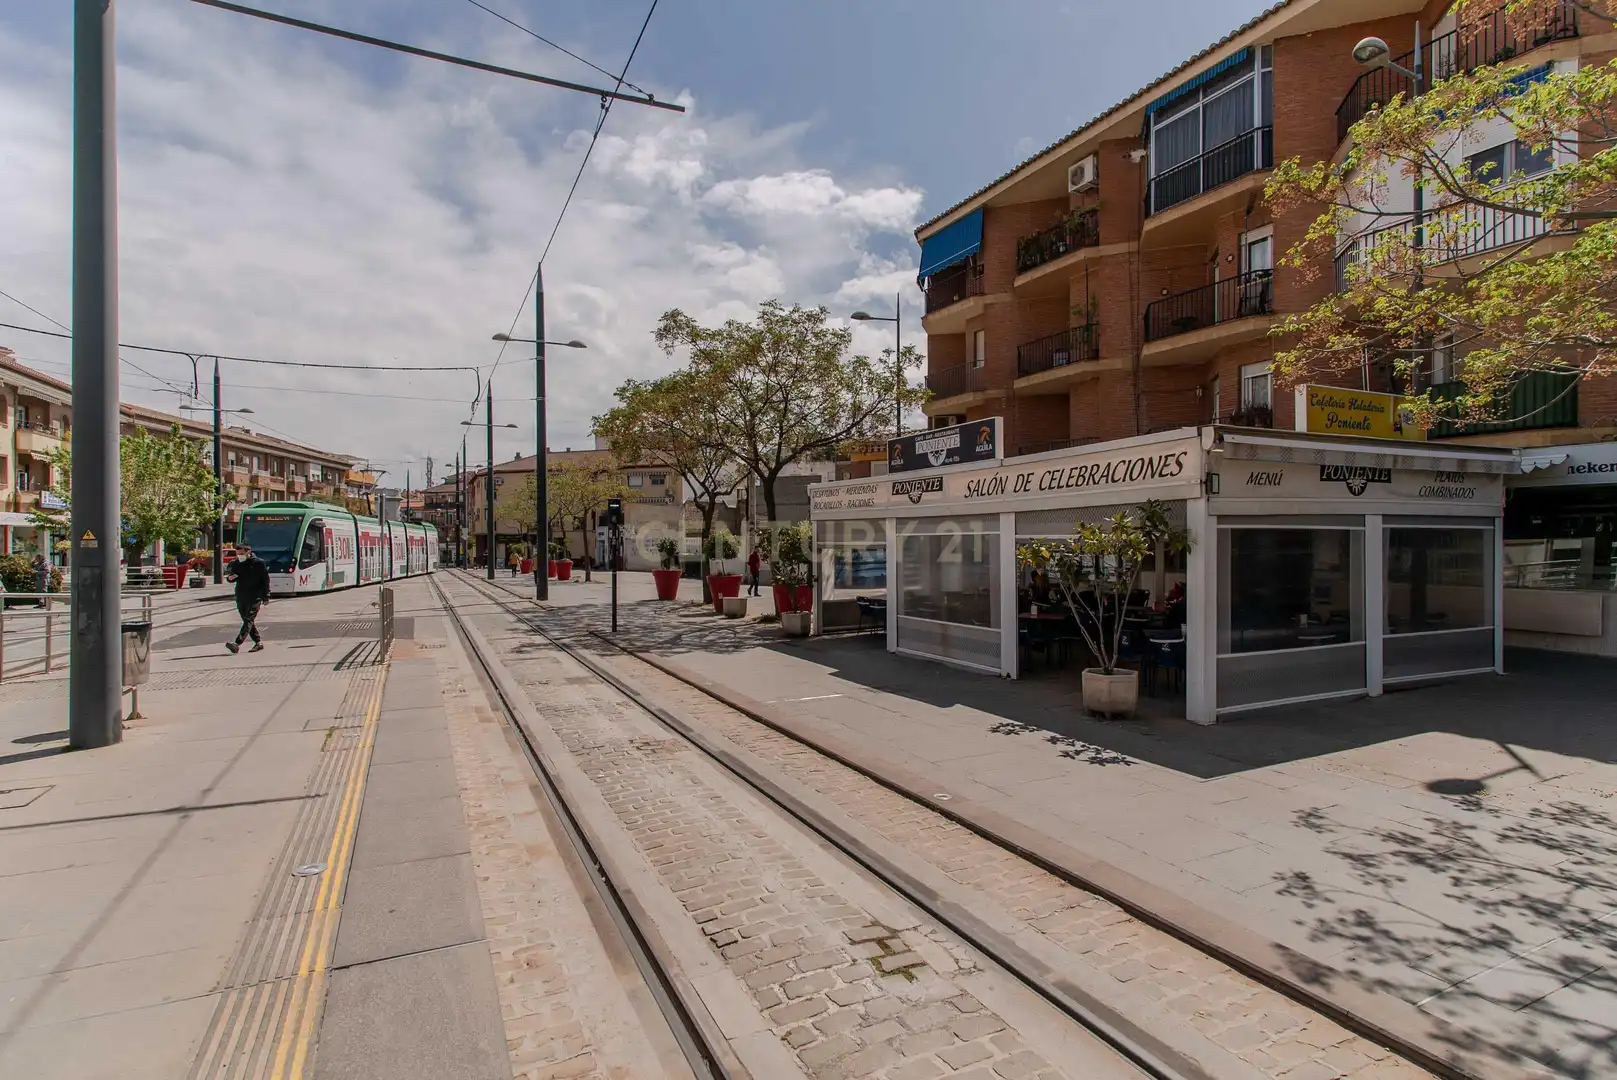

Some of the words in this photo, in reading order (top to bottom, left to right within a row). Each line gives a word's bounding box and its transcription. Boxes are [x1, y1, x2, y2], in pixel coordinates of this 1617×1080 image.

[1325, 411, 1372, 431] Poniente
[916, 436, 959, 453] PONIENTE
[963, 471, 1009, 498] SALÓN
[1013, 472, 1035, 494] DE
[1038, 451, 1188, 492] CELEBRACIONES
[1245, 469, 1284, 487] MENÚ
[1321, 465, 1389, 481] PONIENTE
[1434, 471, 1465, 483] PLATOS
[845, 484, 878, 496] MERIENDAS
[892, 478, 942, 494] PONIENTE
[1418, 485, 1476, 499] COMBINADOS
[813, 500, 843, 510] BOCADILLOS
[847, 498, 876, 509] RACIONES
